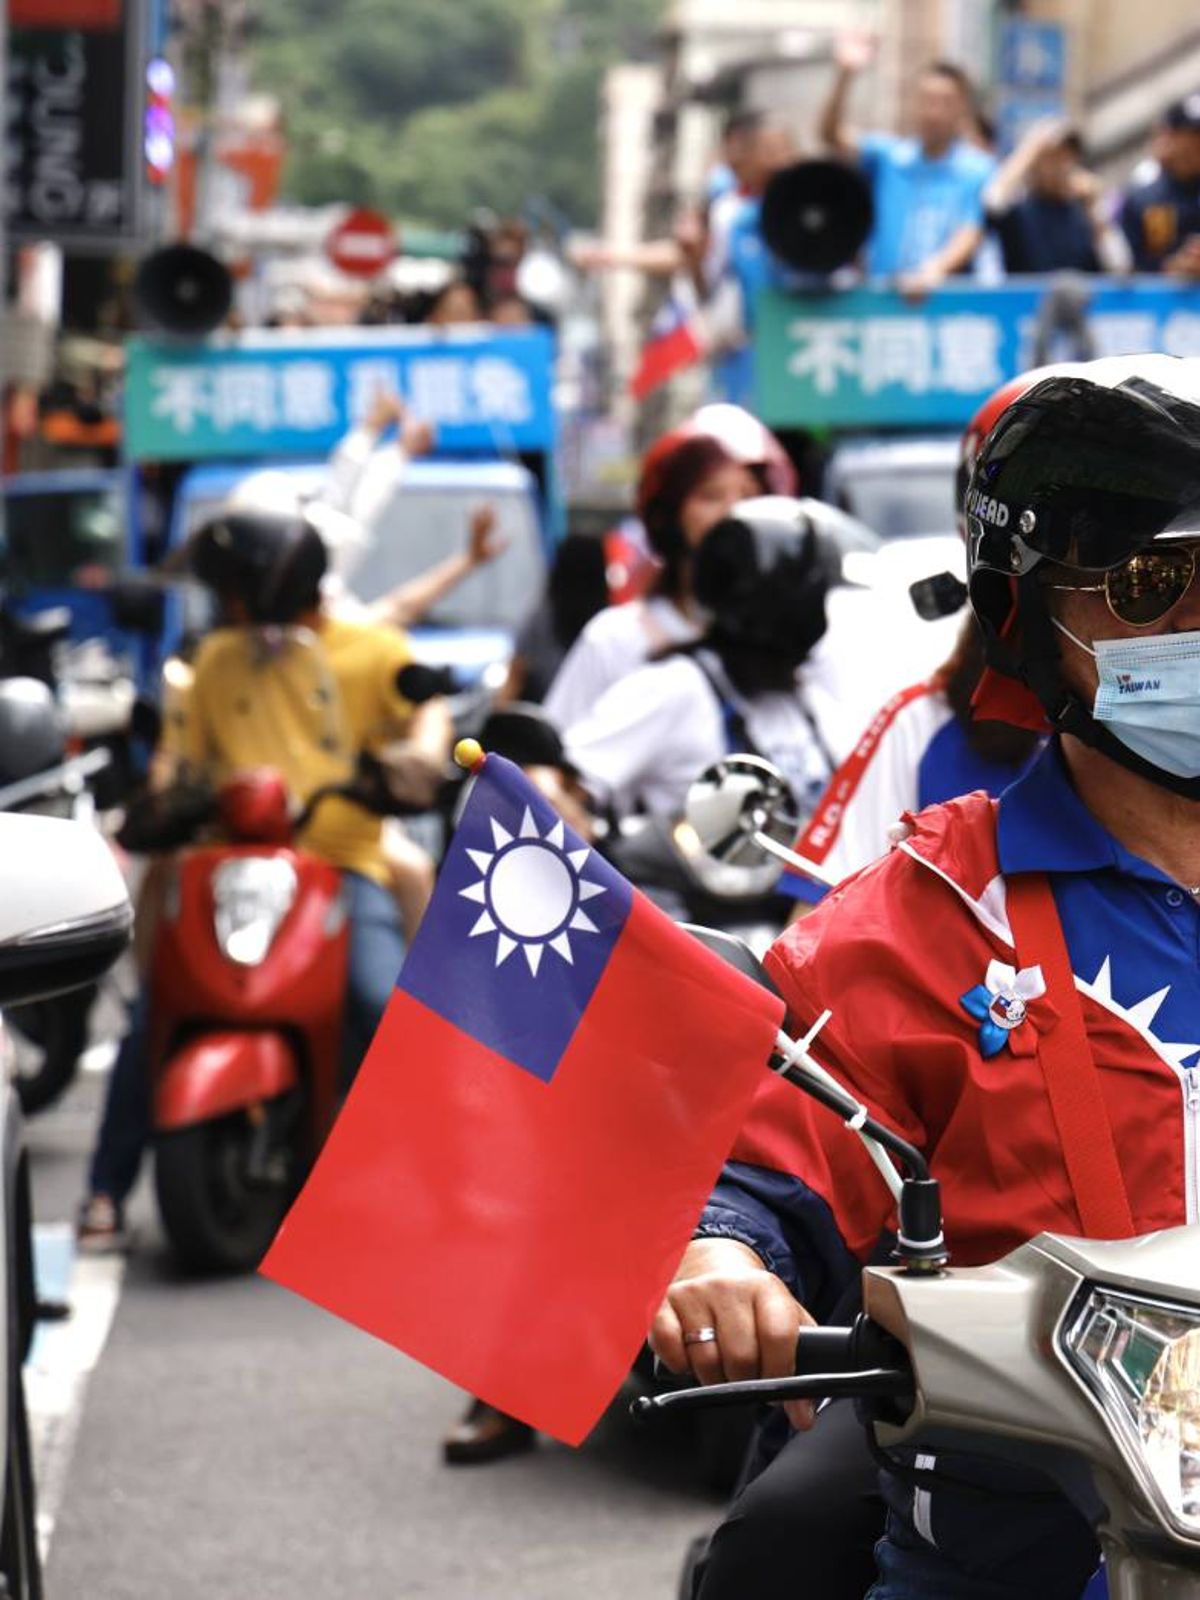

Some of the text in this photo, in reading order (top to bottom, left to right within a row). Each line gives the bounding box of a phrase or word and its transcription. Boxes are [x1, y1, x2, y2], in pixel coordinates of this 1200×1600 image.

[787, 316, 1000, 395] 不同意
[150, 360, 336, 434] 不同意
[1118, 679, 1160, 694] TAIWAN
